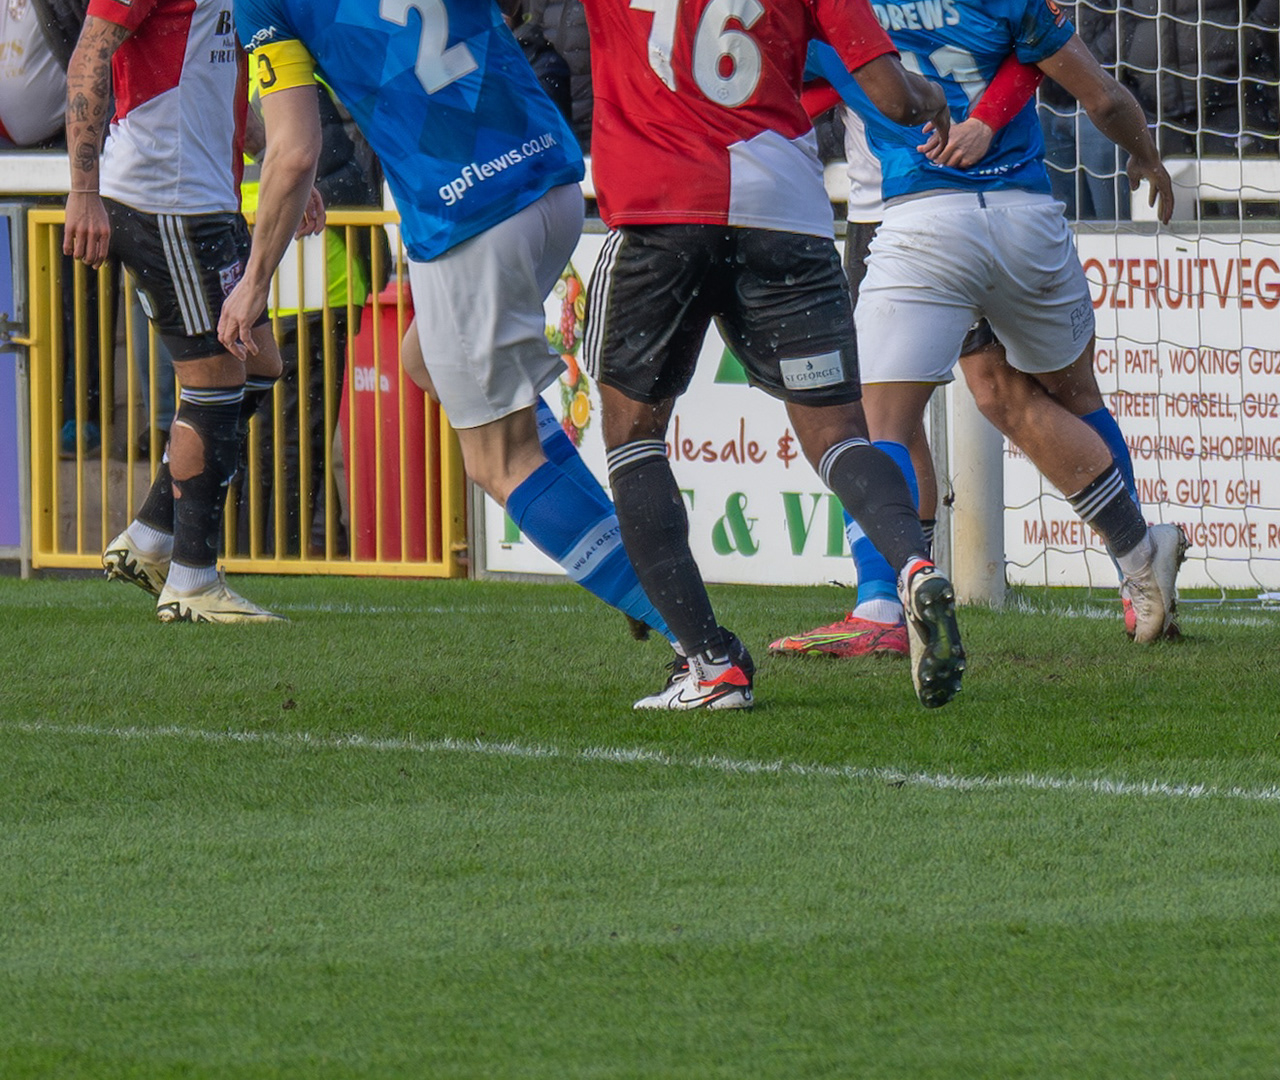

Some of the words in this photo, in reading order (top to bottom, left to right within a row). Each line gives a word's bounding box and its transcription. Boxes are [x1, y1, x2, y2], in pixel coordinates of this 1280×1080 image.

[664, 414, 768, 465] lesale
[776, 427, 799, 470] &
[1127, 435, 1195, 461] WOKING
[1175, 478, 1219, 505] GU21
[1225, 479, 1262, 505] 6GH
[710, 491, 761, 558] &
[1023, 519, 1087, 546] MARKET
